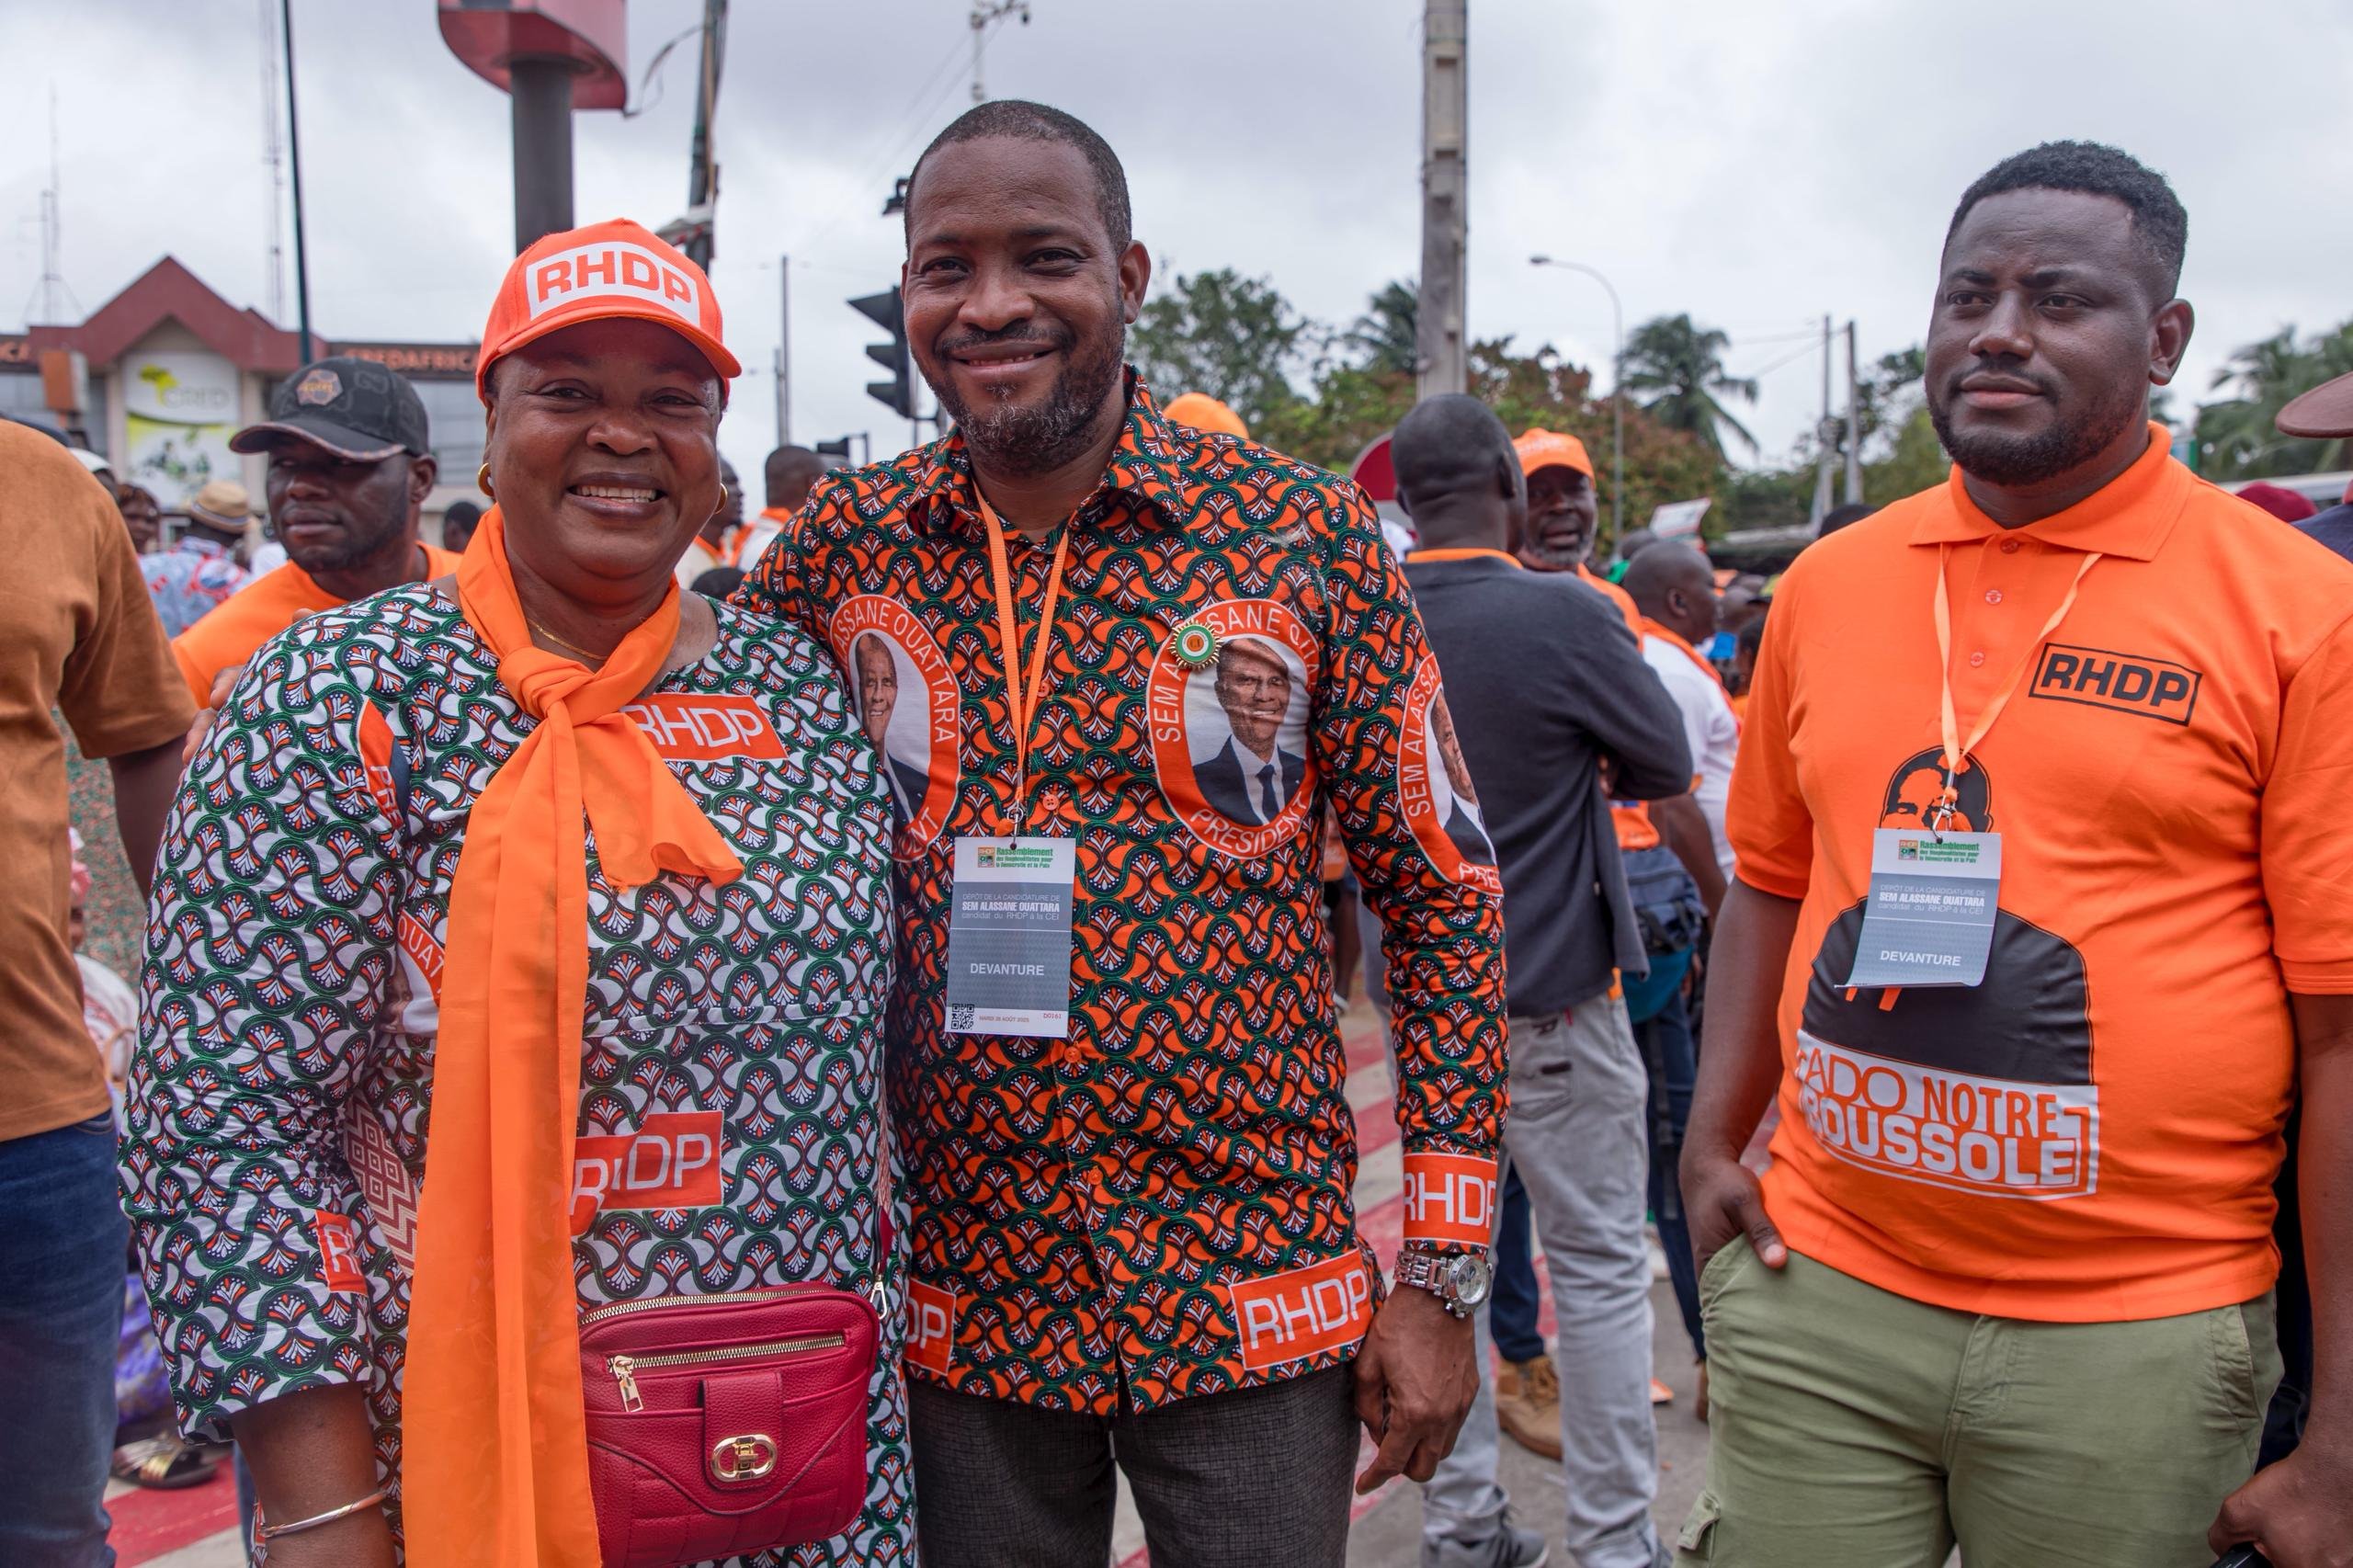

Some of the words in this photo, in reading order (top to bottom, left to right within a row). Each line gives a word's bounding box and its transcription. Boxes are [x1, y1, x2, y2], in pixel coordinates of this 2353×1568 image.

[537, 250, 691, 304] RHDP
[1161, 604, 1283, 682] ASANE
[893, 612, 956, 744] OUATTARA
[2040, 653, 2189, 707] RHDP
[619, 704, 764, 748] RHDP
[1154, 684, 1180, 743] SEM
[1403, 764, 1430, 817] SEM
[1190, 790, 1308, 855] PRESIDENT
[996, 847, 1053, 857] Rassemblement
[961, 902, 979, 911] SEM
[980, 902, 1018, 912] ALASSANE
[1018, 902, 1060, 912] OUATTARA
[1878, 903, 1911, 911] candidat
[1927, 904, 1952, 913] RHDP
[1879, 892, 1898, 902] SEM
[1899, 893, 1941, 904] ALASSANE
[1942, 895, 1985, 907] OUATTARA
[397, 915, 445, 994] OUAT
[970, 962, 1045, 976] DEVANTURE
[1880, 949, 1962, 967] DEVANTURE
[1805, 1047, 1907, 1112] ADO
[1923, 1075, 2059, 1139] NOTRE
[1802, 1085, 2075, 1186] BOUSSOLE
[1244, 1268, 1368, 1350] RHDP
